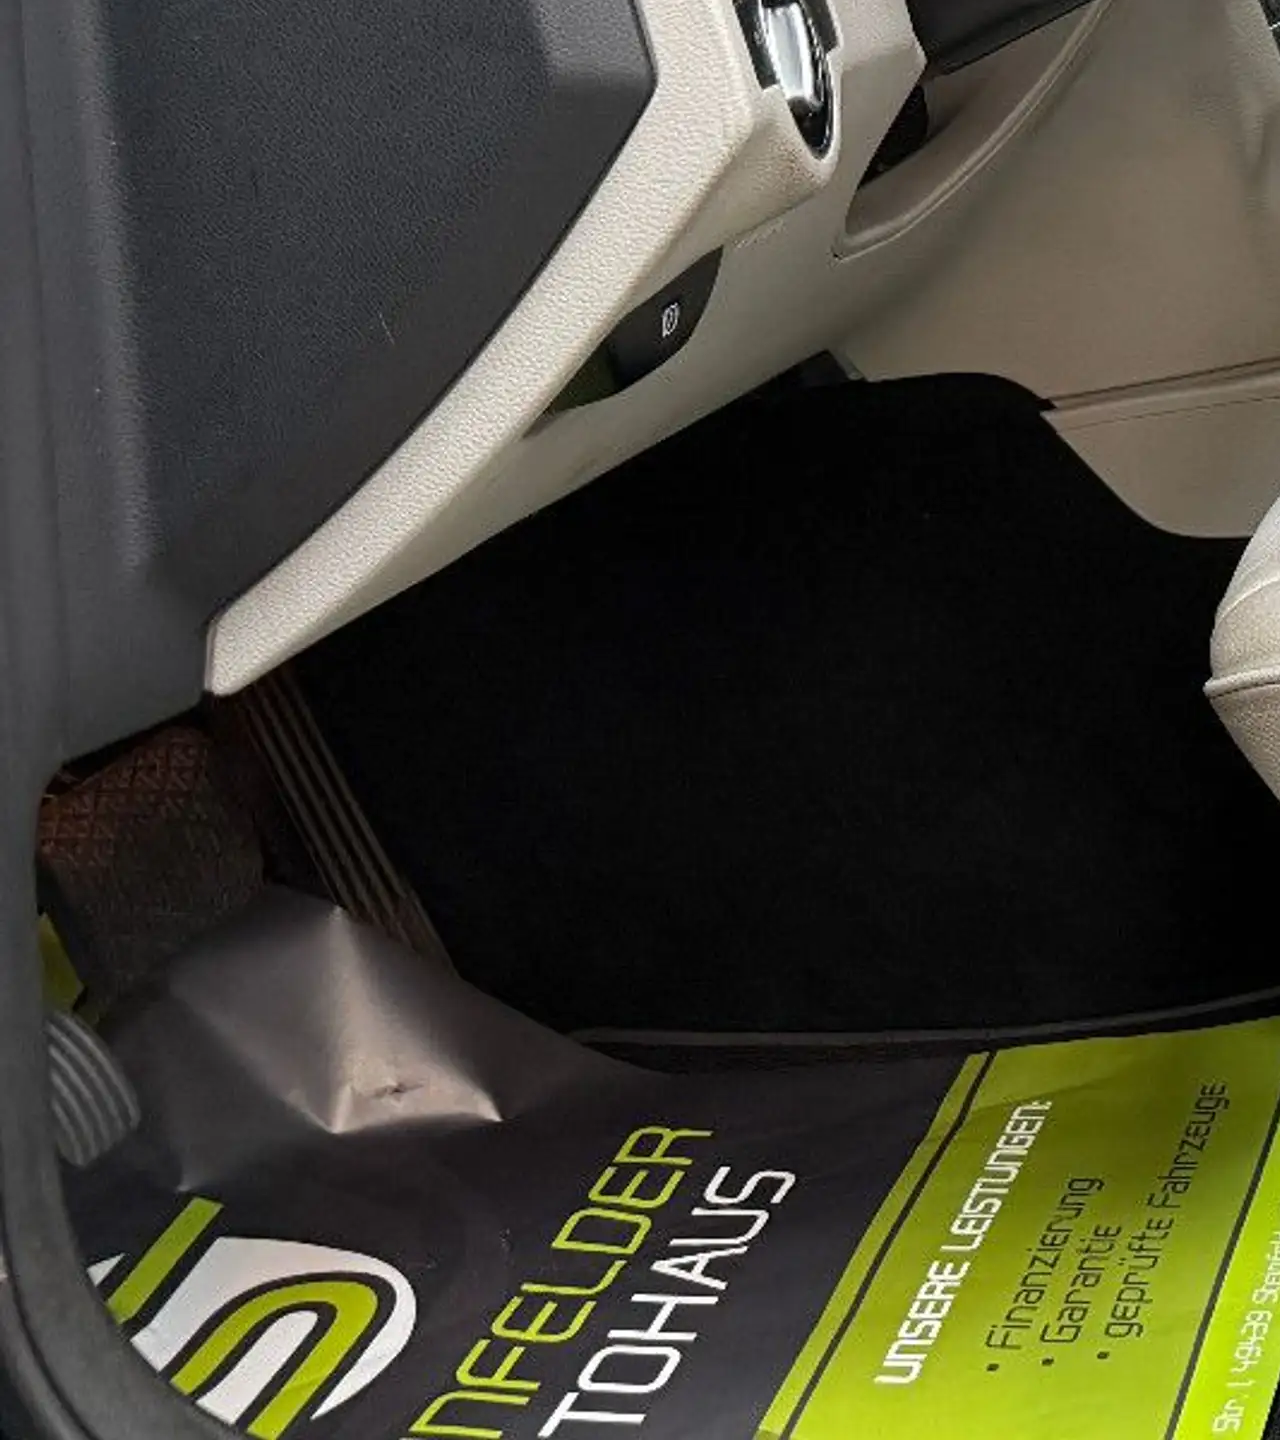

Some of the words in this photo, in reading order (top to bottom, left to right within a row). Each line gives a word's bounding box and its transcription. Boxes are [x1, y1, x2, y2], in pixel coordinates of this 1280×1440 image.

[536, 1165, 797, 1438] TOHAUS
[873, 1259, 971, 1385] UNSERE
[941, 1099, 1053, 1252] LEISTUNGEN:
[985, 1175, 1105, 1351] Finanzierung
[1038, 1222, 1123, 1345] Garantie
[1104, 1216, 1175, 1339] geprüfte
[1146, 1081, 1231, 1209] Fahrzeuge
